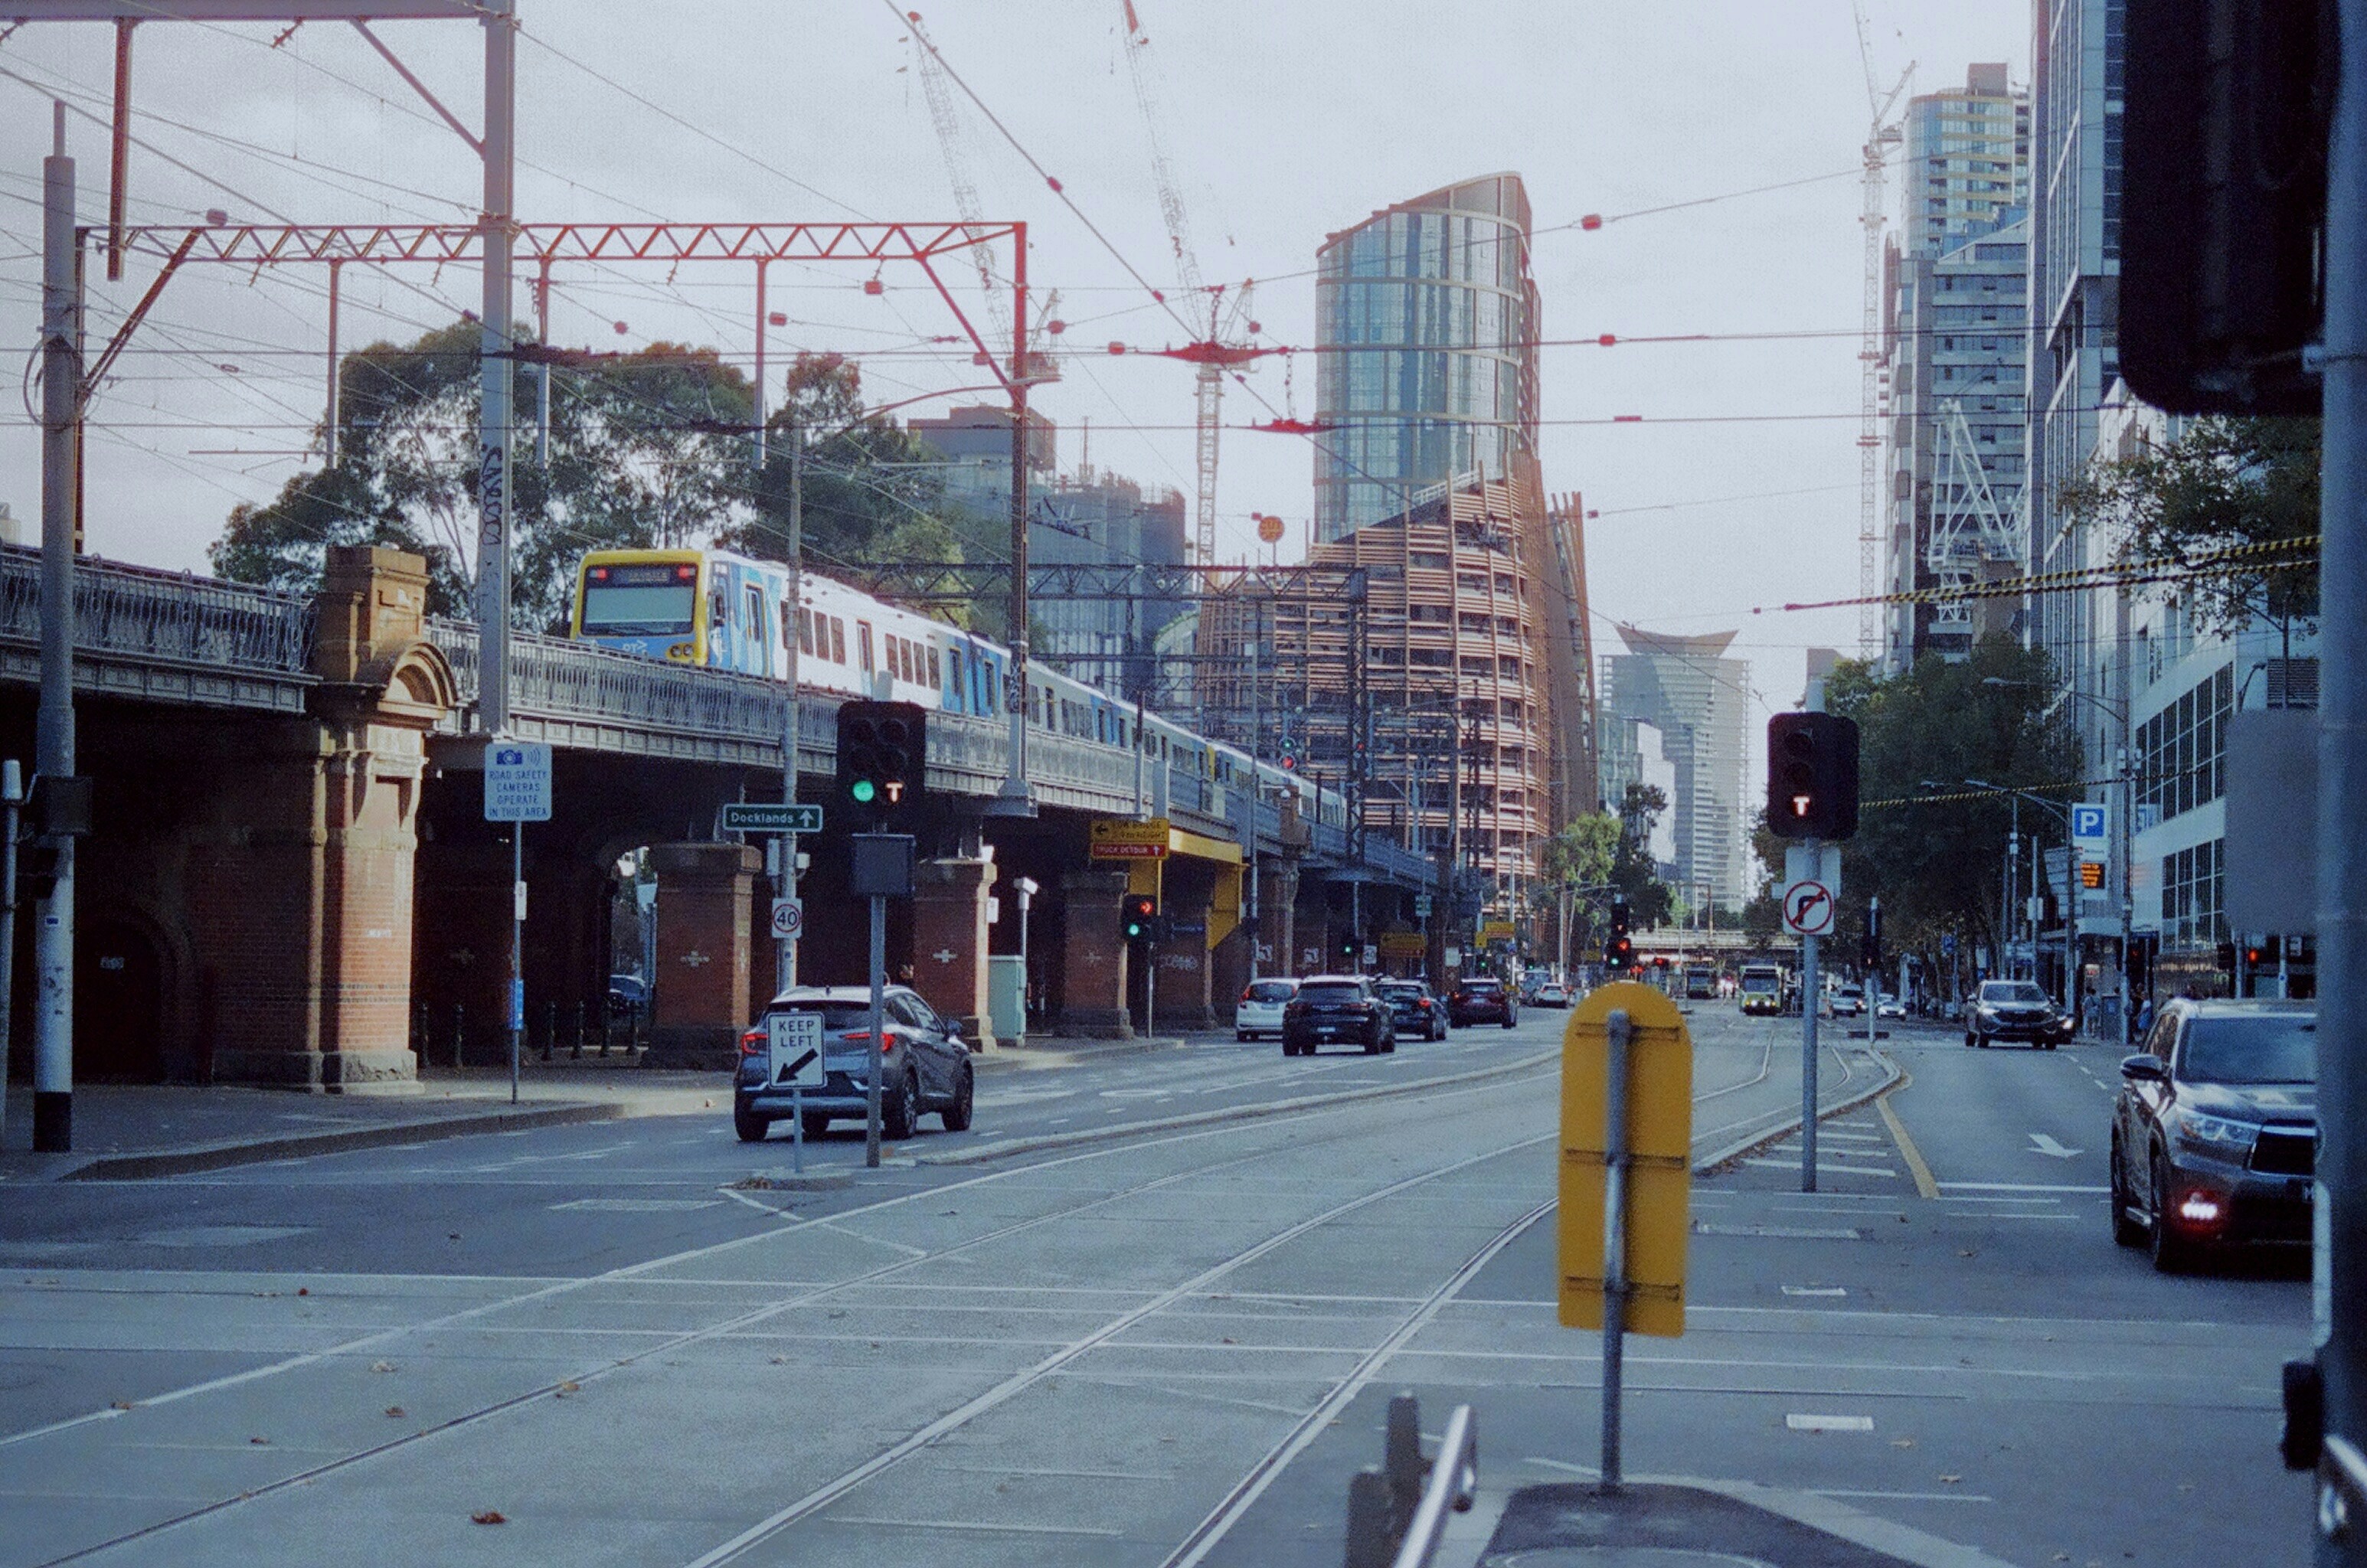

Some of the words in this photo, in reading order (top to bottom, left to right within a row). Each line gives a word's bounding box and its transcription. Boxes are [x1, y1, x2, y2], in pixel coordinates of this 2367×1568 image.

[489, 770, 512, 779] ROAD
[515, 769, 547, 779] SAFETY
[496, 782, 541, 792] CAMERAS
[497, 795, 538, 805] OPERATE
[489, 808, 499, 818] IN
[502, 807, 521, 818] THIS
[525, 807, 548, 817] AREA
[731, 812, 794, 824] Docklands
[2080, 812, 2100, 834] P
[776, 911, 798, 926] 40
[778, 1020, 815, 1032] KEEP
[780, 1035, 813, 1047] LEFT
